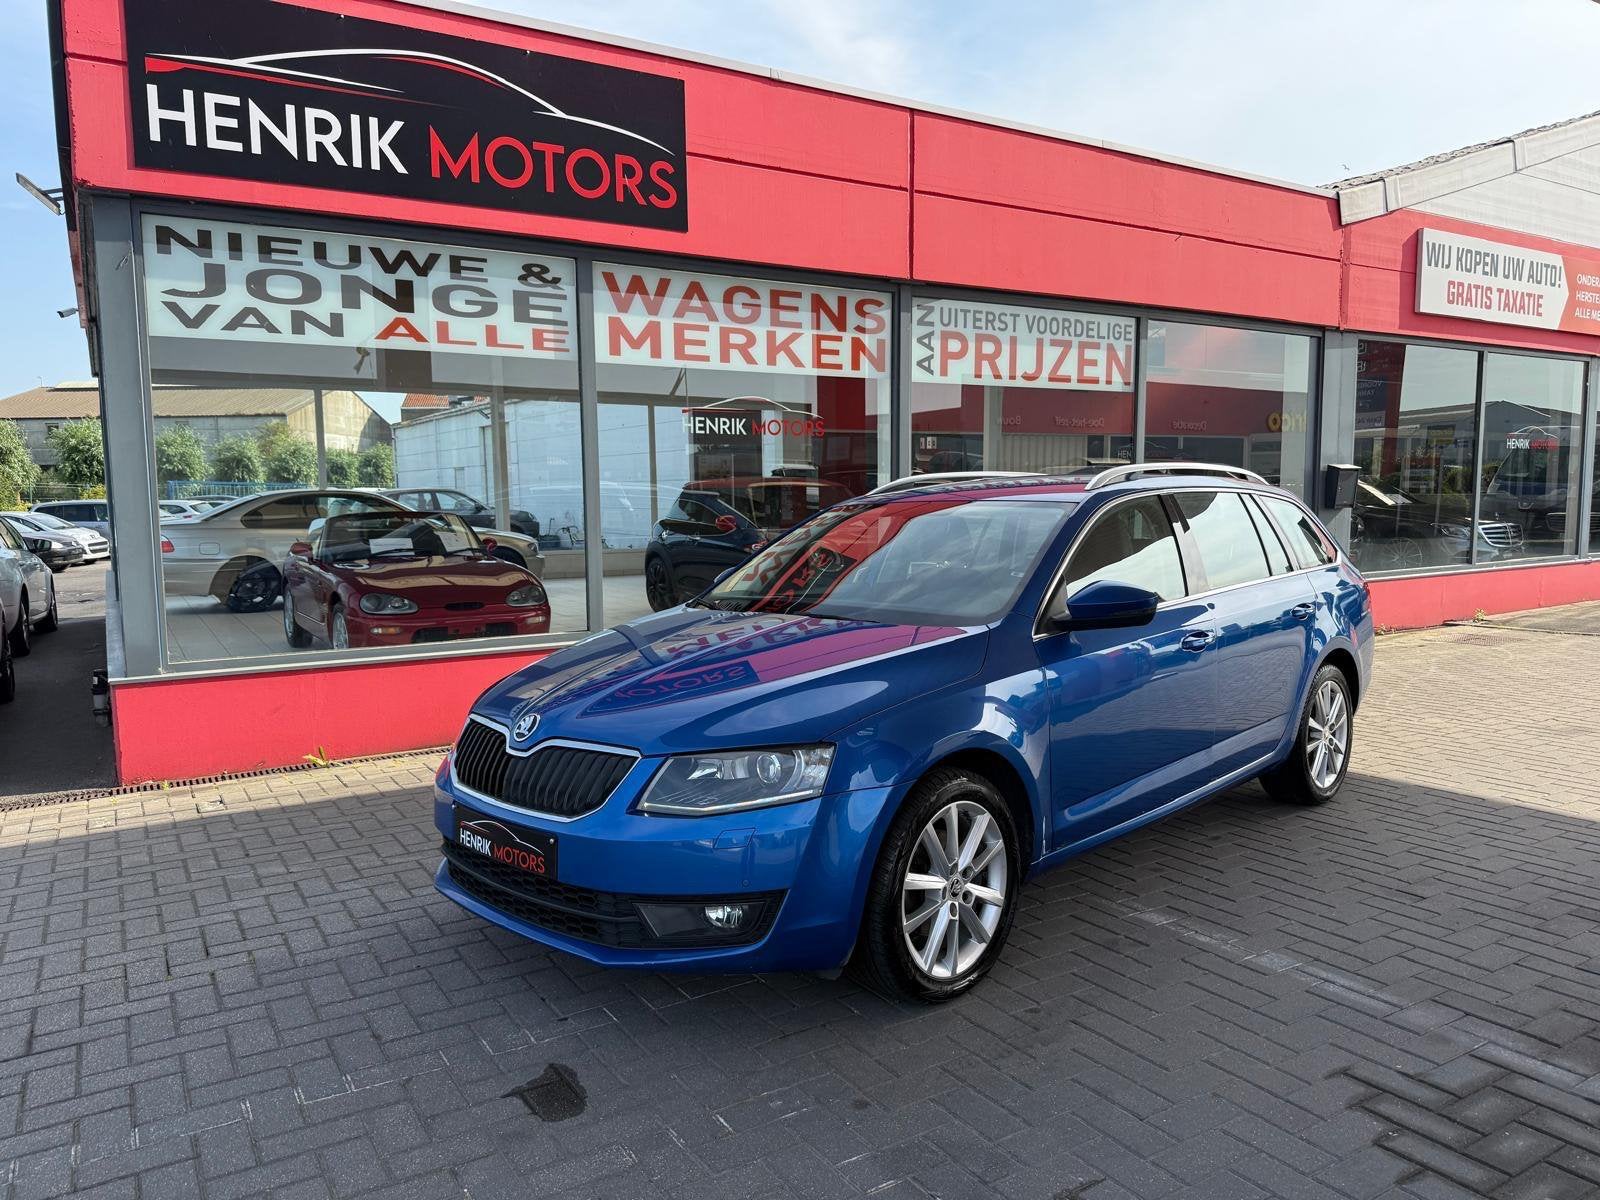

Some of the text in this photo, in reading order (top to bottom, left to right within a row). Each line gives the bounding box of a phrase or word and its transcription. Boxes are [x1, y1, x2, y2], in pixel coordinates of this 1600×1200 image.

[146, 83, 677, 209] HENRIK MOTORS
[155, 225, 563, 291] NIEUWE &
[1426, 241, 1562, 288] WIJ KOPEN UW AUTO!
[161, 264, 568, 326] JONGE
[601, 270, 886, 335] WAGENS
[1446, 280, 1543, 317] GRATIS TAXATIE
[1574, 307, 1591, 320] ALLE
[161, 300, 570, 353] VAN ALLE
[607, 316, 886, 373] MERKEN
[916, 304, 935, 376] AAN
[939, 307, 1133, 342] UITERST VOORDELIGE
[939, 330, 1132, 386] PRIJZEN
[682, 416, 825, 438] HENRIK MOTORS
[1506, 438, 1530, 449] HENRIK
[460, 828, 545, 874] HENRIK MOTORS
